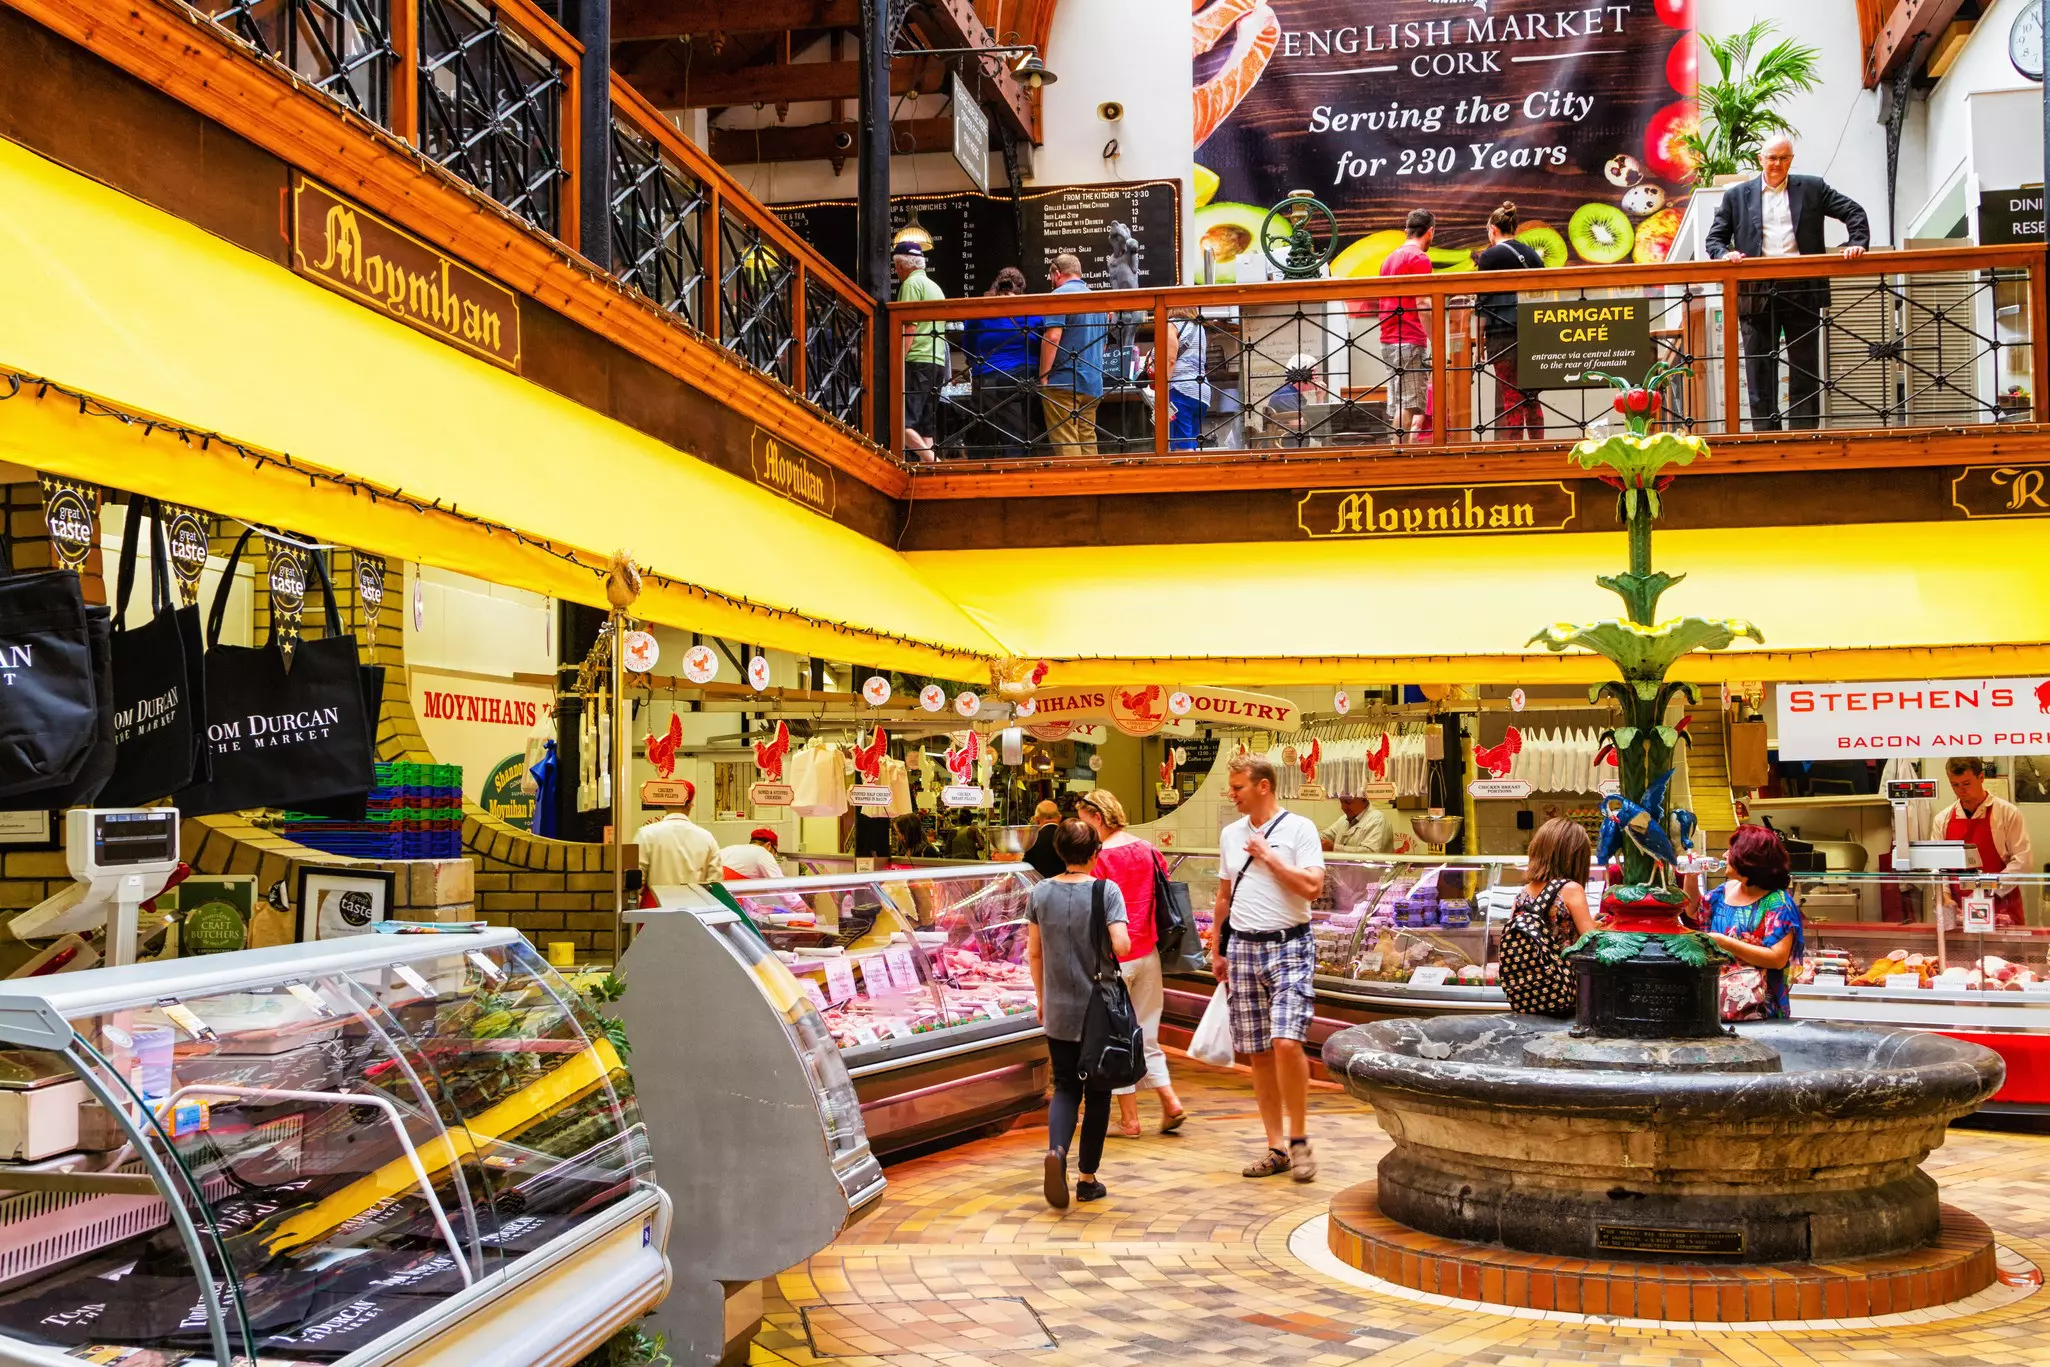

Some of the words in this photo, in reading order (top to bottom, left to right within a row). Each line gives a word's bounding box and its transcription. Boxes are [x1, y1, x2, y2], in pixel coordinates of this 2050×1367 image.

[1283, 20, 1451, 57] ENGLISH
[1466, 6, 1631, 44] MARKET
[1411, 51, 1501, 77] CORK
[1308, 102, 1445, 133] Serving
[1456, 96, 1510, 124] the
[1523, 90, 1594, 122] City
[1334, 151, 1387, 185] for
[1397, 147, 1456, 175] 230
[1469, 144, 1568, 172] Years
[1063, 193, 1081, 201] FROM
[1082, 192, 1093, 200] THE
[1094, 190, 1119, 200] KITCHEN
[905, 202, 947, 212] SANDWICHES
[313, 204, 501, 352] Moynihan
[1533, 306, 1634, 324] FARMGATE
[1560, 323, 1608, 342] CAFÉ
[1531, 352, 1566, 361] entrance
[1568, 351, 1580, 359] via
[1583, 349, 1611, 359] central
[1613, 349, 1636, 357] stairs
[1540, 362, 1549, 370] to
[1550, 361, 1563, 369] the
[1584, 359, 1593, 369] of
[1593, 359, 1627, 369] fountain
[764, 438, 825, 506] Moynihan
[59, 506, 81, 520] great
[1331, 488, 1535, 533] Moynihan
[50, 516, 91, 542] taste
[179, 529, 198, 541] great
[171, 538, 206, 563] taste
[280, 565, 296, 577] great
[271, 574, 304, 596] taste
[360, 583, 382, 602] taste
[1790, 681, 2014, 713] STEPHEN'S
[115, 708, 134, 730] OM
[138, 686, 179, 722] DURCAN
[424, 691, 536, 727] MOYNIHANS
[138, 710, 177, 736] MARKET
[207, 721, 241, 742] OM
[247, 707, 339, 737] DURCAN
[254, 728, 330, 748] MARKET
[1838, 735, 1921, 748] BACON
[1932, 734, 1983, 746] AND
[1994, 732, 2050, 745] POR
[489, 799, 527, 820] Moynihan
[341, 899, 372, 918] taste
[191, 930, 239, 939] BUTCHERS
[201, 921, 231, 930] CRAFT
